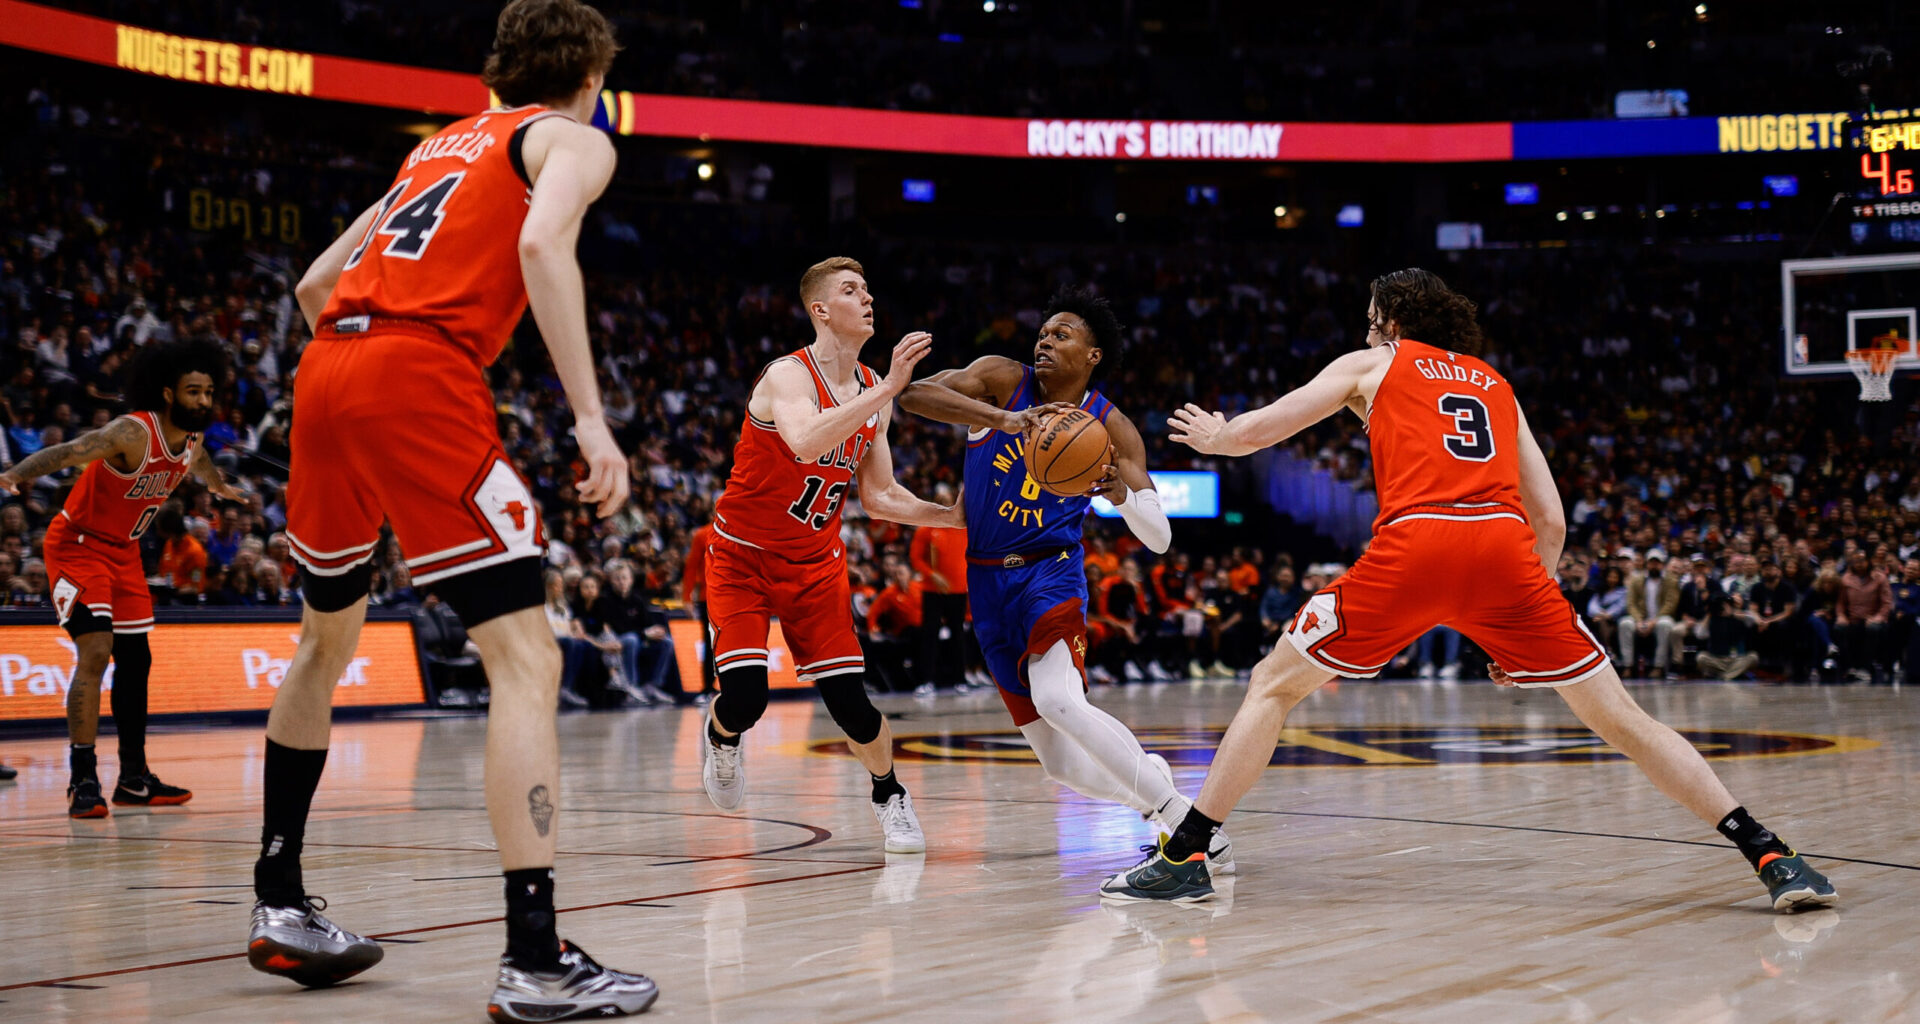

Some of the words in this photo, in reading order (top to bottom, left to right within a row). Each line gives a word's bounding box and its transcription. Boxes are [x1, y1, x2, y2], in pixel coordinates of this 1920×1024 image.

[116, 24, 313, 96] NUGGETS.COM
[1027, 120, 1146, 158] ROCKY'S
[1149, 121, 1283, 158] BIRTHDAY
[343, 171, 467, 271] 14
[1414, 358, 1498, 392] GIDDEY
[1040, 411, 1088, 452] Wilson
[1438, 392, 1497, 463] 3
[129, 504, 160, 541] 0
[787, 475, 848, 531] 13
[998, 500, 1044, 528] CITY
